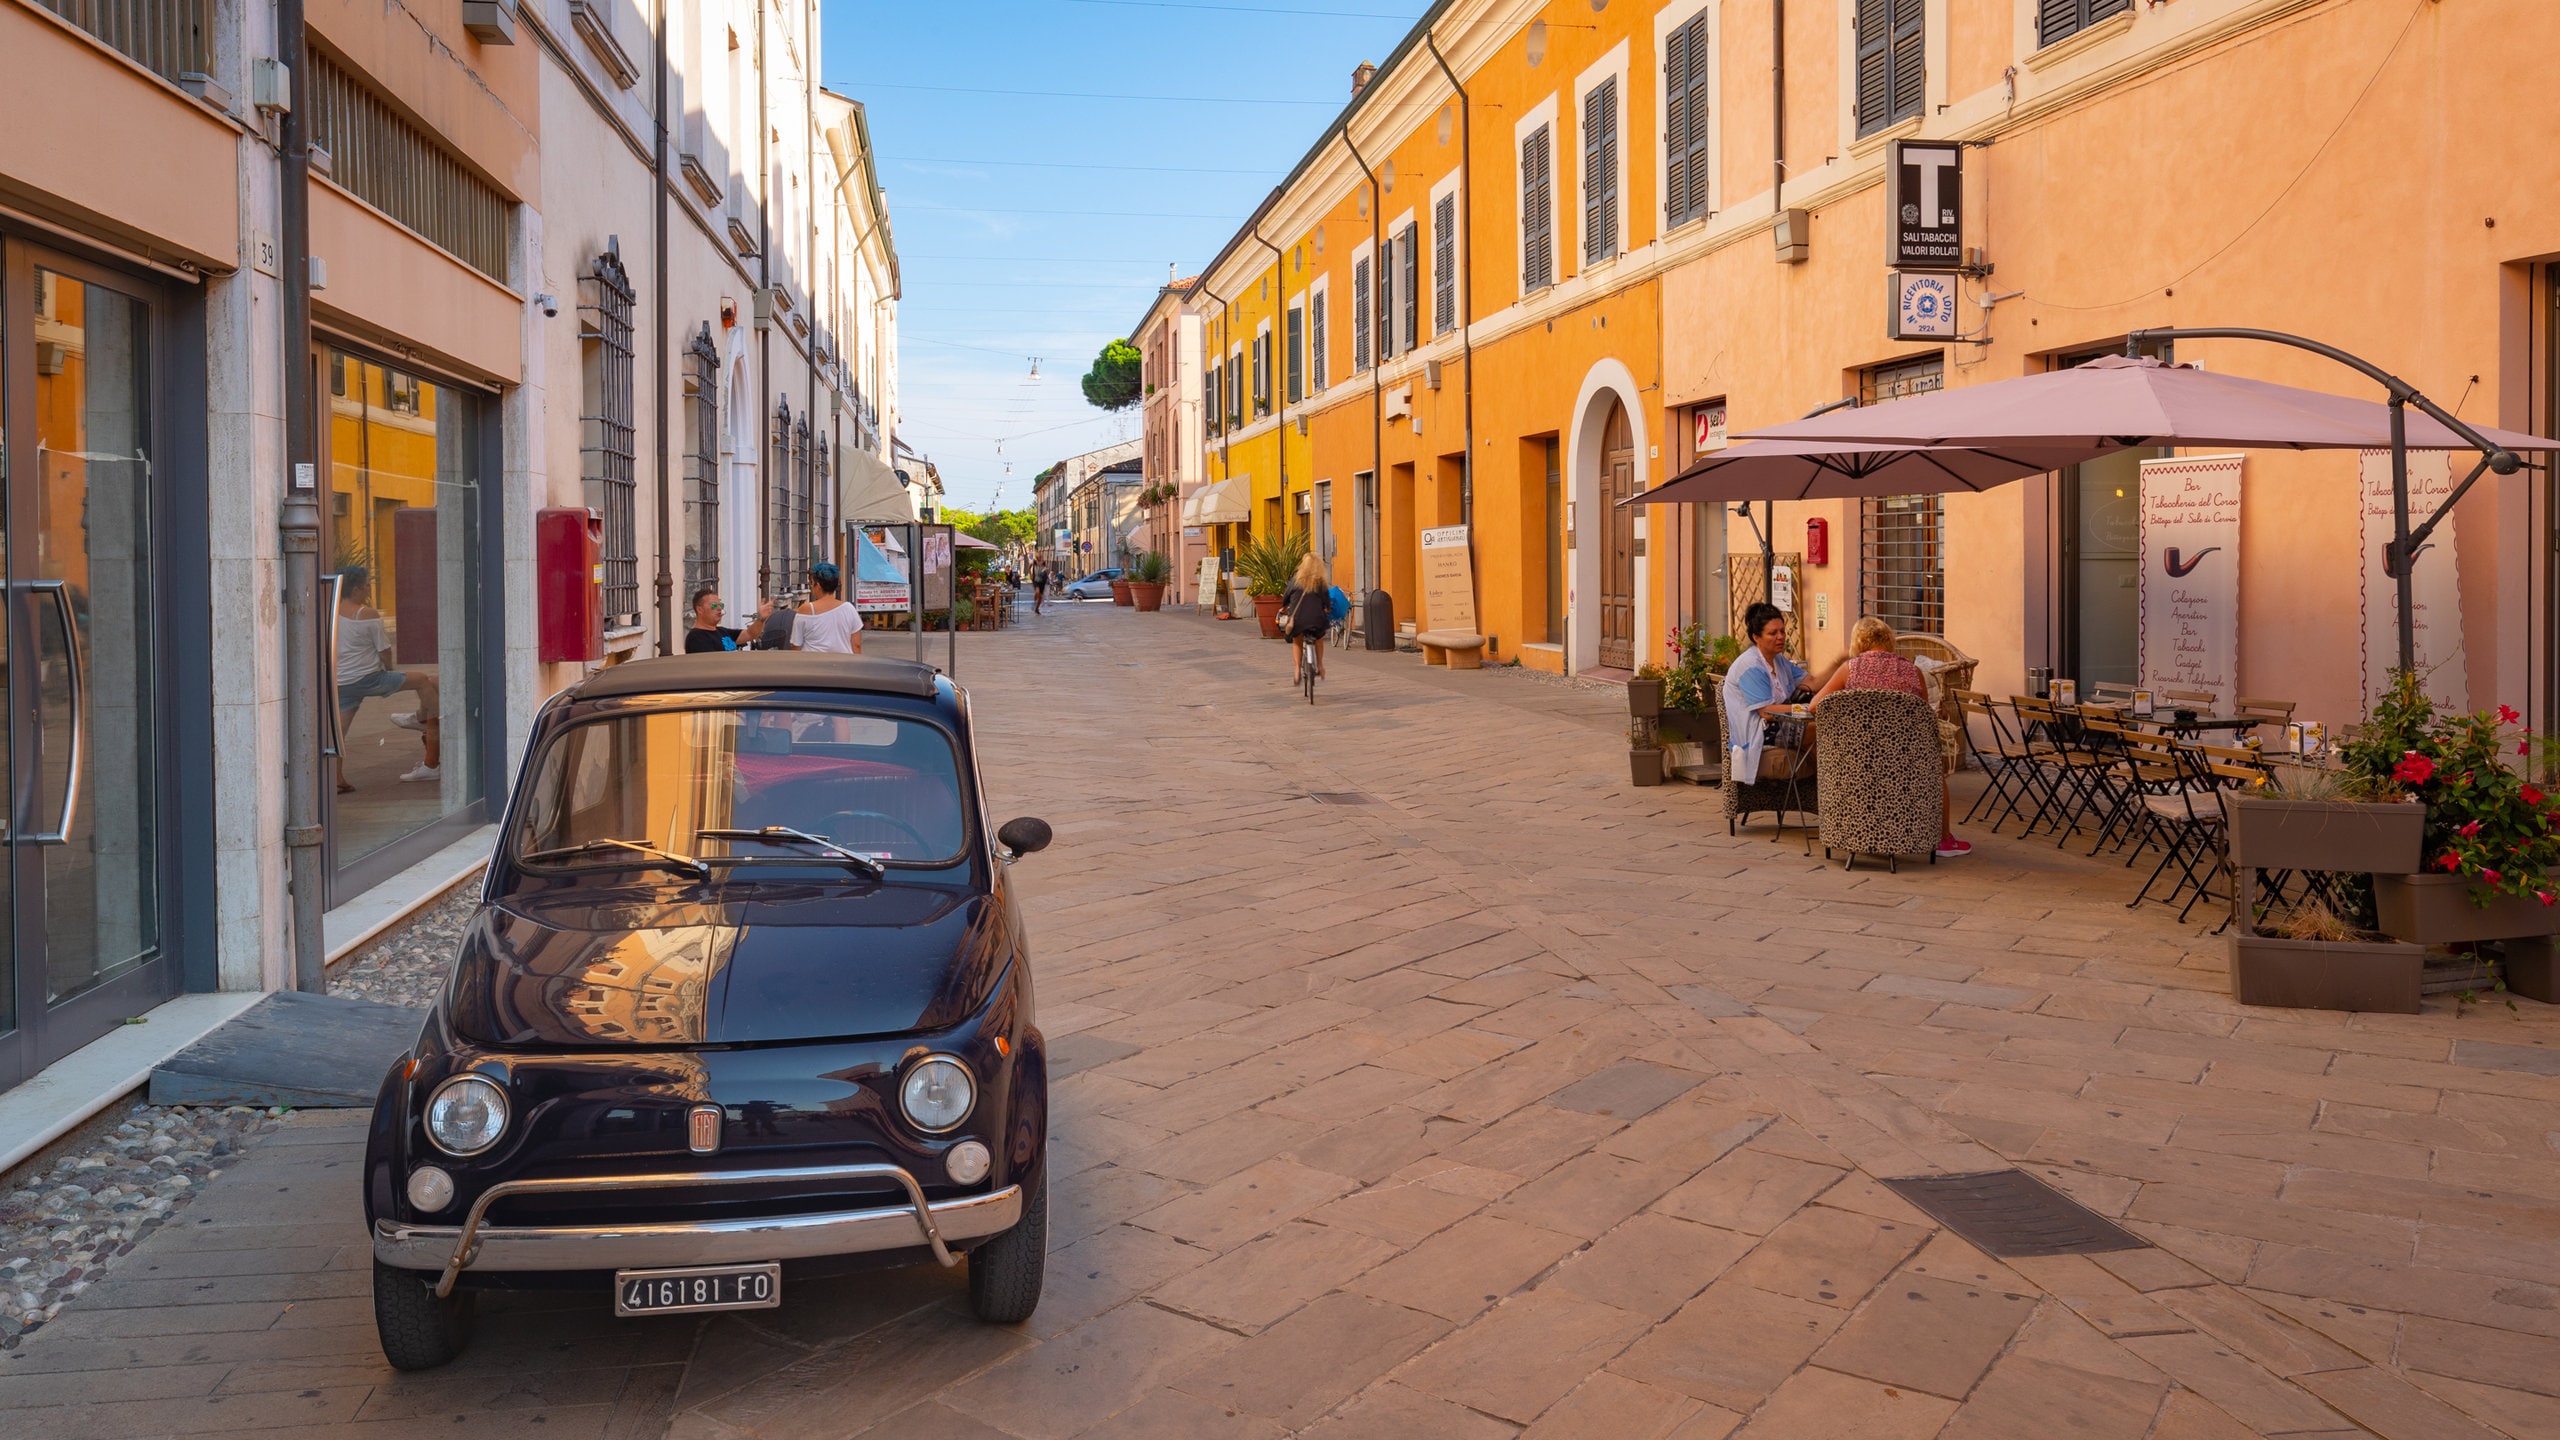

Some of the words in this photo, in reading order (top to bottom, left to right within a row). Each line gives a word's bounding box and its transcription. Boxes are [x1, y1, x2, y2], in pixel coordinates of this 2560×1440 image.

[1903, 148, 1956, 228] T
[1903, 232, 1920, 242] SALI
[1920, 233, 1958, 243] TABACCHI
[261, 242, 273, 267] 39
[1902, 246, 1928, 255] VALORI
[1930, 247, 1959, 256] BOLLATI
[1903, 279, 1944, 310] RICEVITORIA
[1941, 295, 1952, 322] LOTTO
[2185, 478, 2201, 491] Bar
[2412, 478, 2424, 494] del
[2425, 478, 2449, 495] Corso
[2151, 494, 2196, 508] Tabaccheria
[2198, 492, 2212, 506] del
[2213, 492, 2238, 506] Corso
[2368, 502, 2388, 519] Bottega
[2150, 513, 2171, 528] Bottega
[2173, 512, 2184, 524] del
[2187, 512, 2204, 524] Sale
[2213, 511, 2237, 523] Cervia
[2171, 589, 2208, 608] Colazioni
[2181, 622, 2197, 636] Bar
[2172, 638, 2206, 652] Tabacchi
[2175, 653, 2202, 674] Gadget
[2153, 669, 2184, 683] Ricariche
[2187, 672, 2224, 689] Telefoniche
[695, 1114, 716, 1146] FIAT
[628, 1278, 719, 1307] 416181
[737, 1275, 769, 1301] FO
